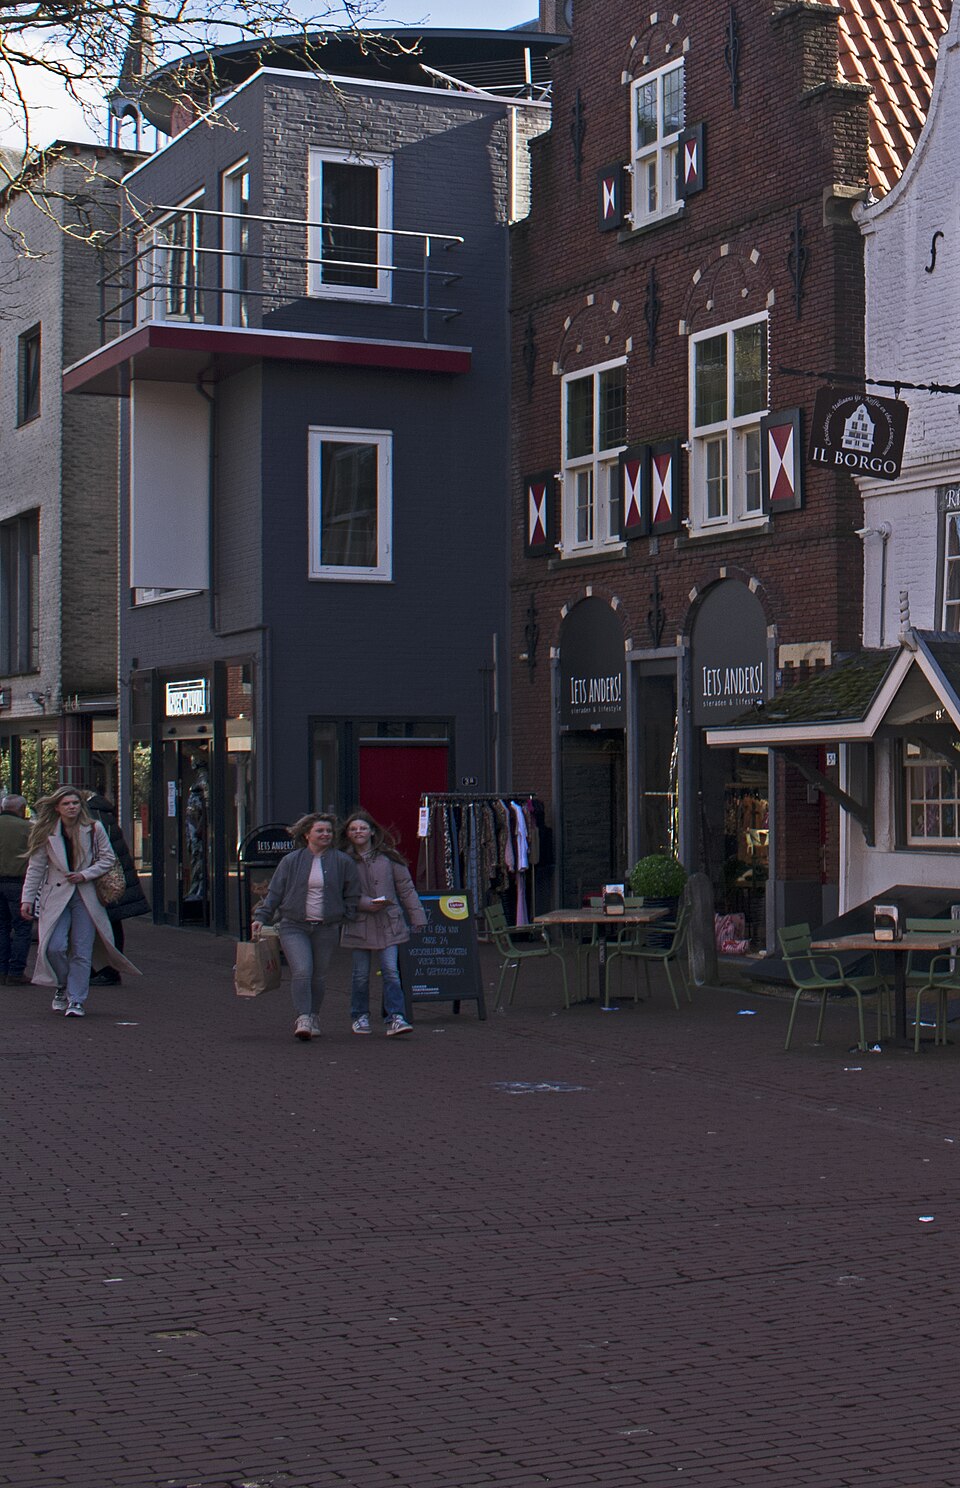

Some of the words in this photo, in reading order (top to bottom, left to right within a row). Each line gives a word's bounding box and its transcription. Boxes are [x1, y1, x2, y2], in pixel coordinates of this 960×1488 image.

[812, 447, 829, 463] IL
[834, 451, 896, 473] BORGO
[588, 672, 622, 703] ANDERS!
[724, 661, 763, 695] ANDERS!
